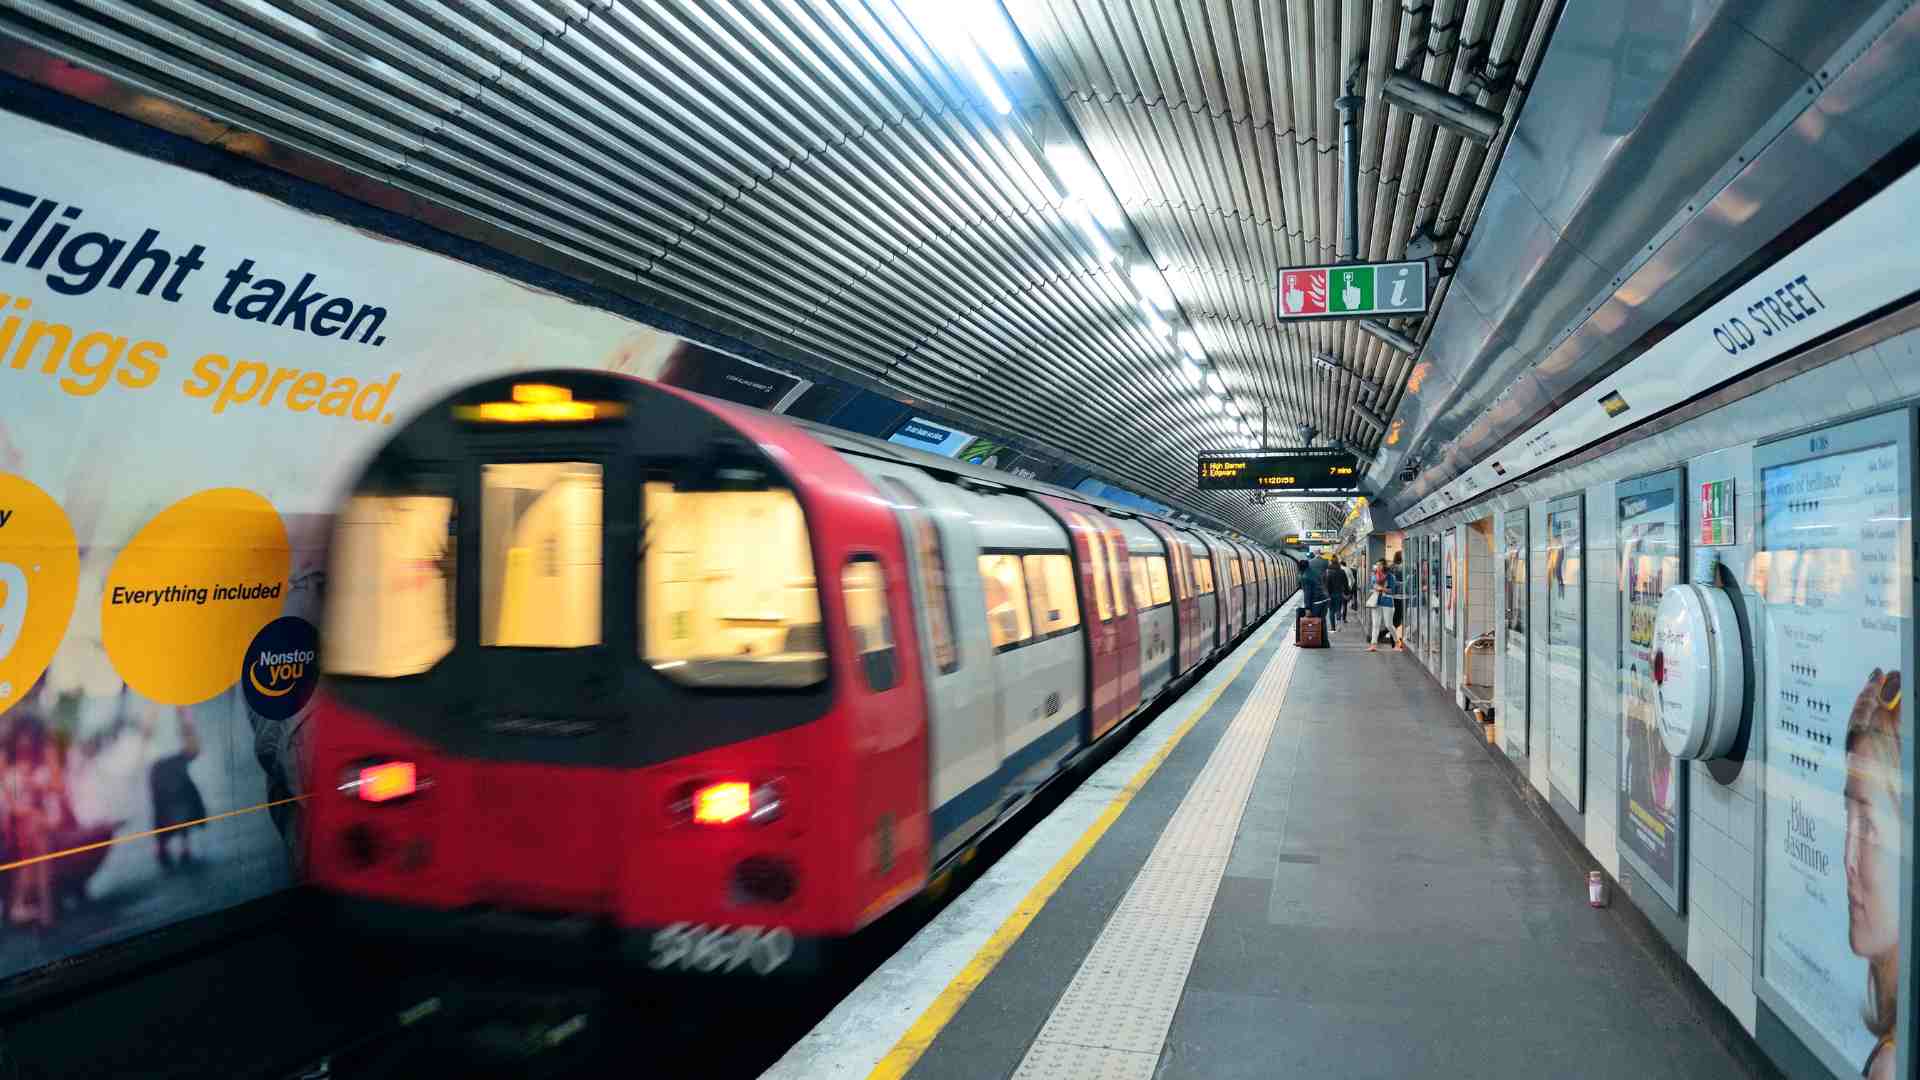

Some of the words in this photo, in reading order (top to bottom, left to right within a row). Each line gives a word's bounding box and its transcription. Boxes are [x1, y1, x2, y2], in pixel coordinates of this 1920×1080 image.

[212, 258, 388, 346] taken.
[1713, 317, 1755, 355] OLD
[1747, 274, 1826, 337] STREET
[0, 291, 169, 397] ings
[182, 352, 402, 424] spread.
[112, 585, 208, 607] Everything
[213, 582, 281, 601] included
[260, 649, 315, 667] Nonstop
[269, 661, 304, 686] you
[1791, 798, 1817, 843] Blue
